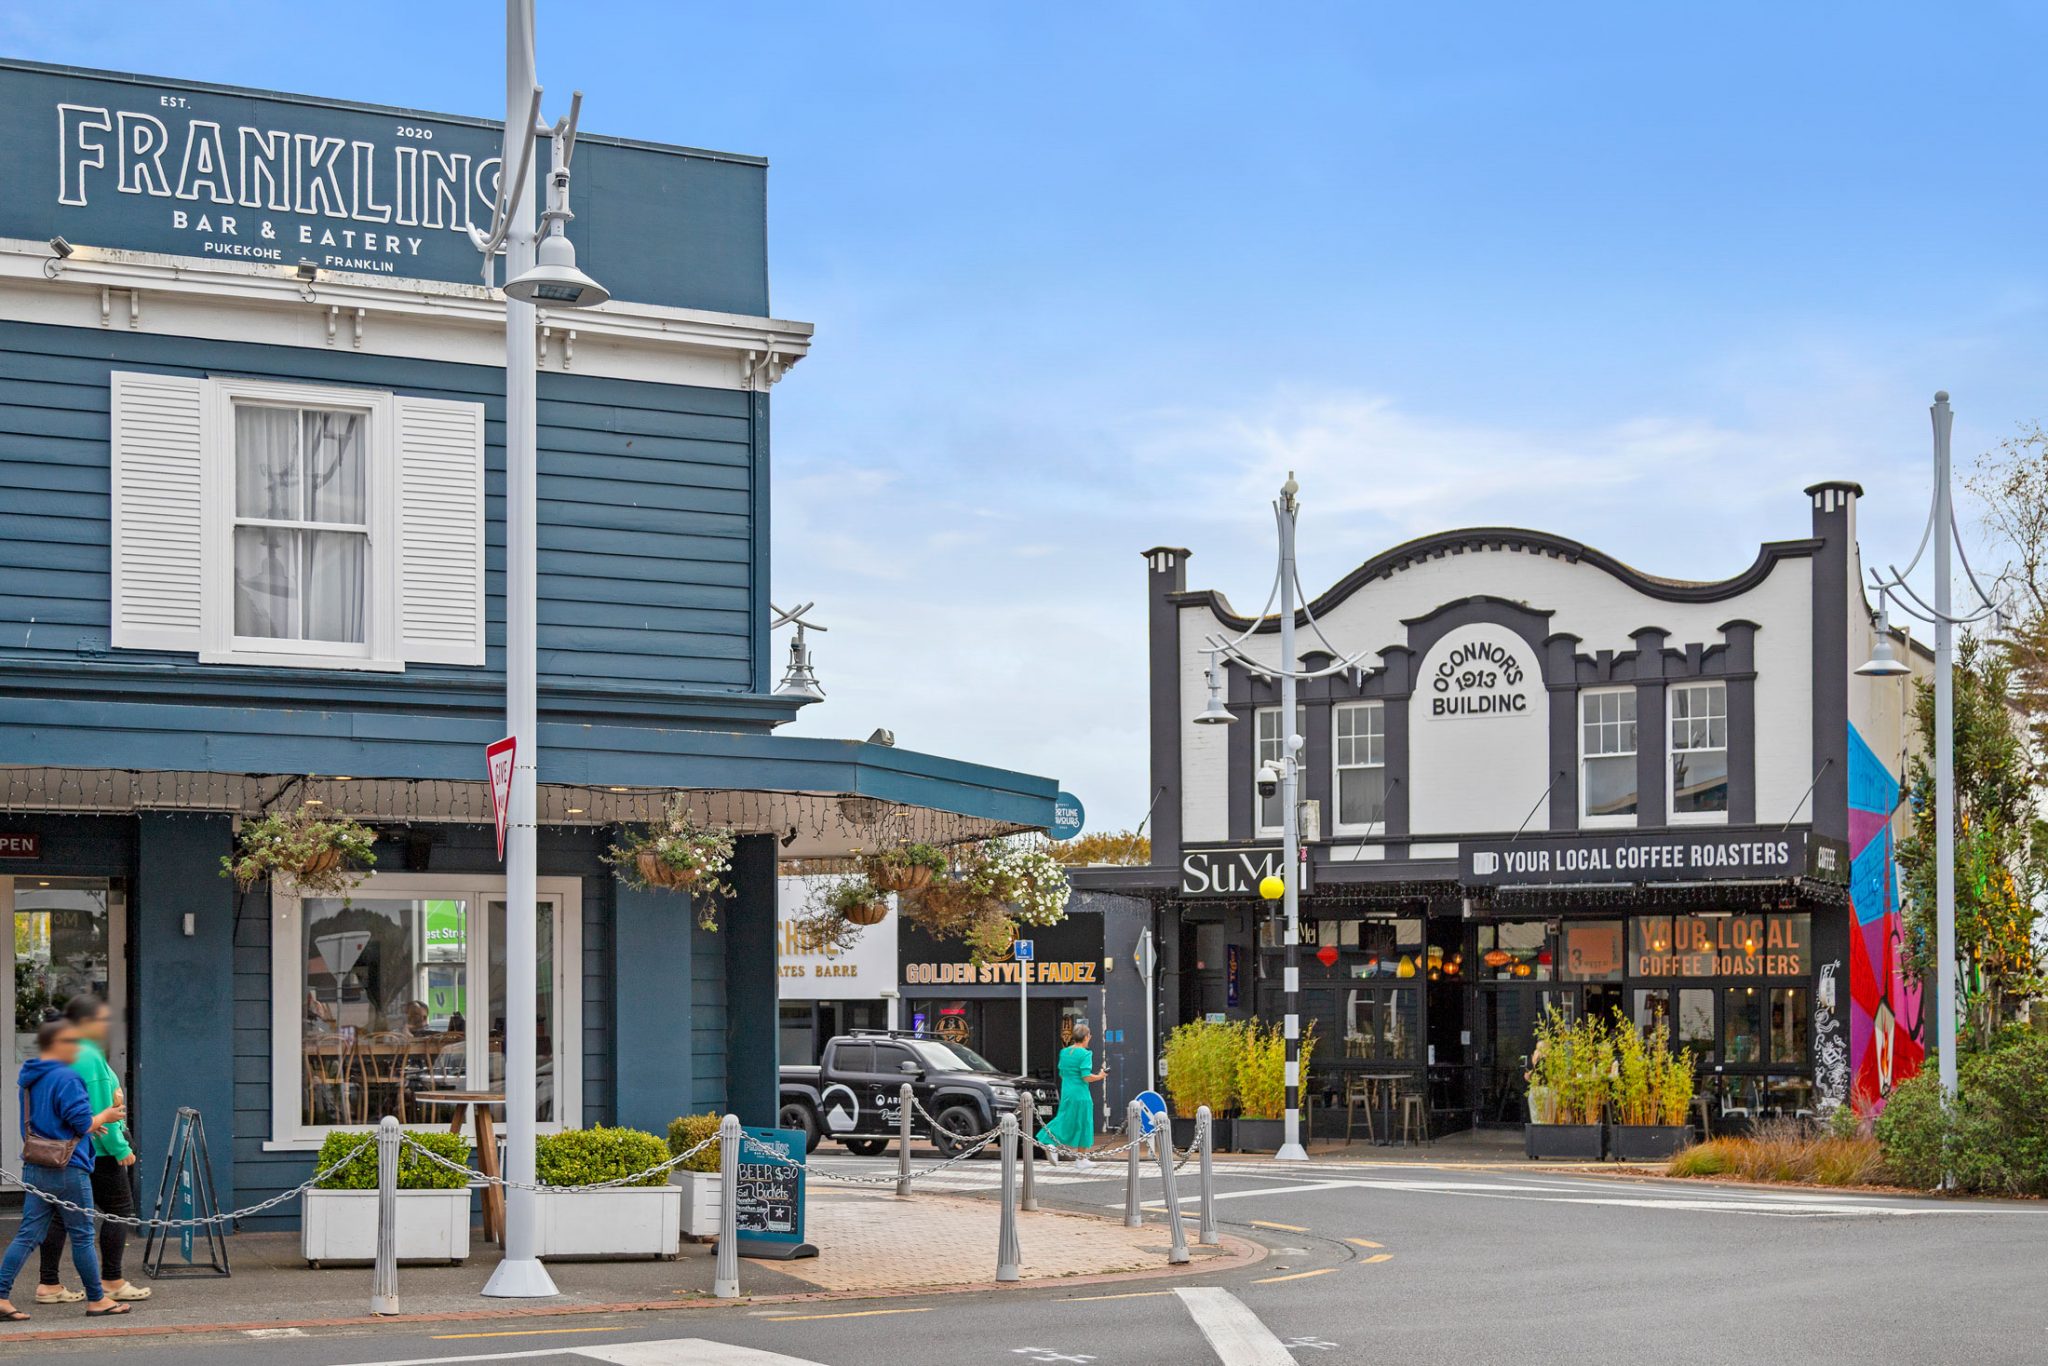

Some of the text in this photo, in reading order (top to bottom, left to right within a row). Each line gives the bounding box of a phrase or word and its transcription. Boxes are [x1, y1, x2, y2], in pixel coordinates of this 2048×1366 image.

[160, 96, 192, 109] EST.
[396, 126, 433, 139] 2020
[173, 210, 423, 256] BAR & EATERY
[204, 242, 393, 272] PUKEKOHE FRANKLIN
[1455, 670, 1497, 692] 1913
[1432, 694, 1526, 716] BUILDING
[1504, 841, 1789, 873] YOUR LOCAL COFFEE ROASTERS
[1818, 846, 1836, 871] COFFEE
[1640, 918, 1799, 952] YOUR LOCAL
[815, 965, 857, 977] BARRE
[906, 961, 1096, 984] GOLDEN STYLE FADEZ
[1640, 954, 1800, 977] COFFEE ROASTERS
[738, 1163, 798, 1180] BEER $30
[756, 1182, 789, 1199] Buckets
